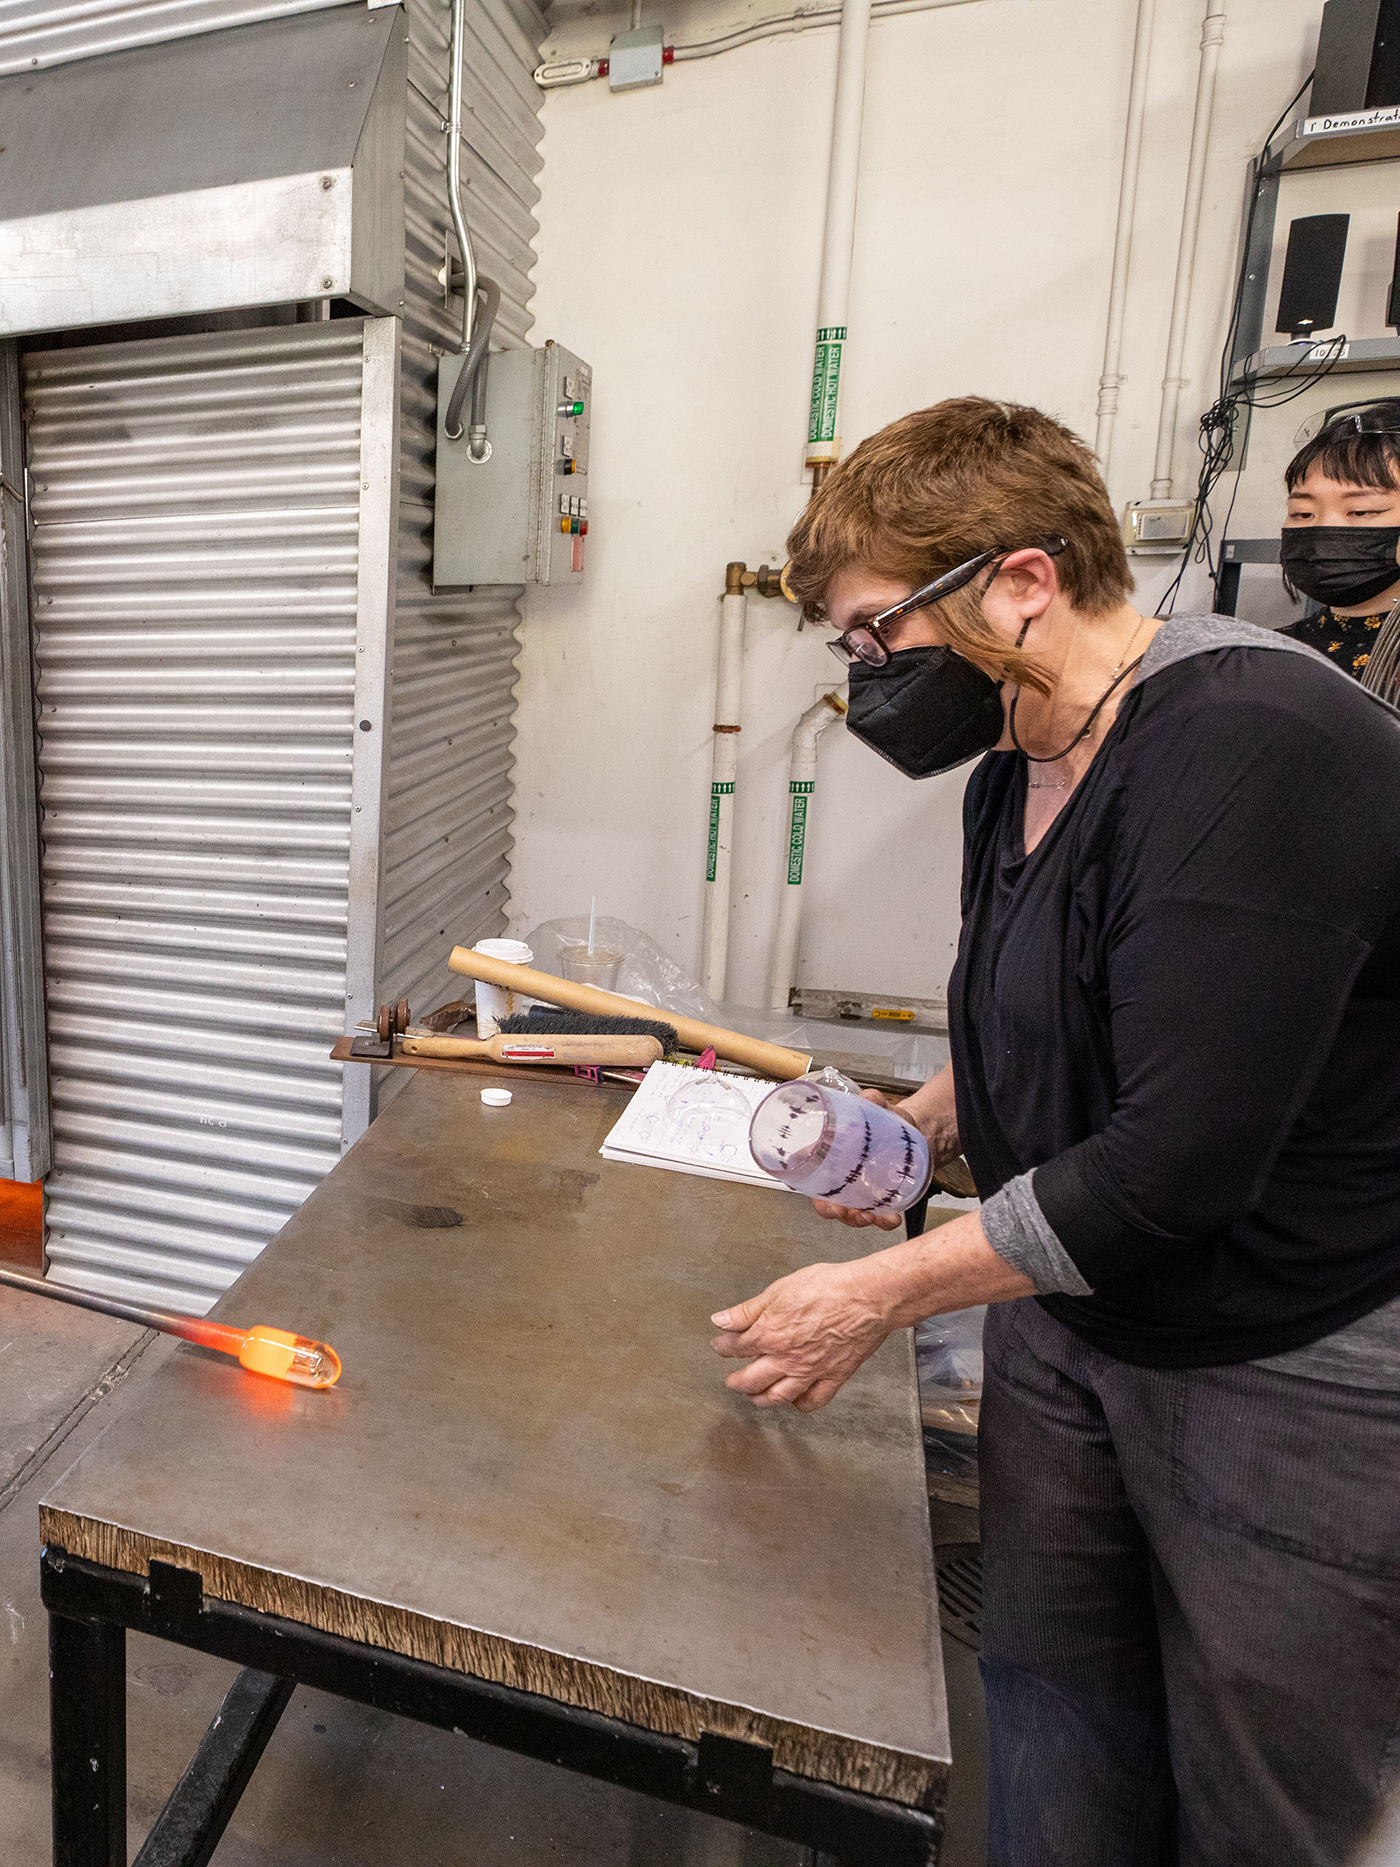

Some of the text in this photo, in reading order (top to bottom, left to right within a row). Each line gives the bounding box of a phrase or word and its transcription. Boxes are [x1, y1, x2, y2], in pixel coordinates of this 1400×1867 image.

[809, 346, 825, 440] DOMESTIC COLD WATER
[821, 347, 840, 438] DOMESTIC HOT WATER
[707, 799, 718, 878] DOMESTIC HOT WATER
[789, 798, 805, 882] DOMESTIC COLD WATER
